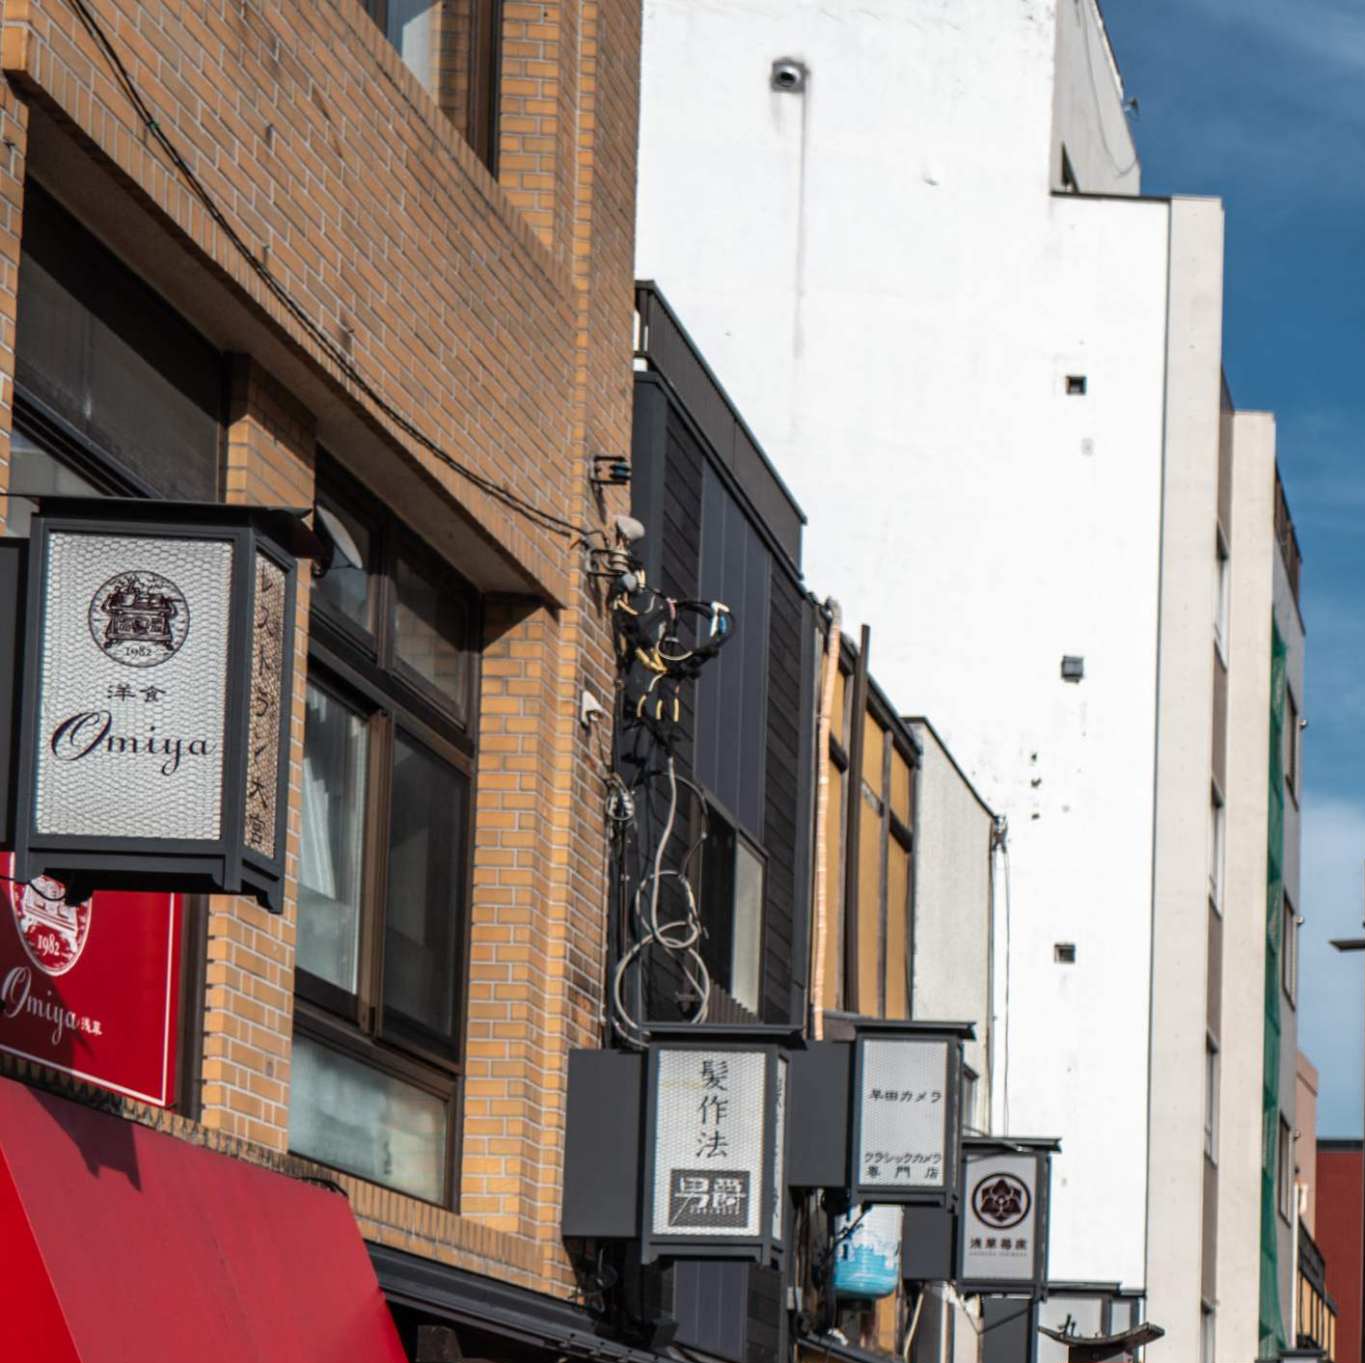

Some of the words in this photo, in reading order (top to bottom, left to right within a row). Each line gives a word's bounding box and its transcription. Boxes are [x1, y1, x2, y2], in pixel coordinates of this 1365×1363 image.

[124, 646, 152, 658] 1982
[106, 684, 167, 703] 洋食
[51, 710, 216, 777] Omiya
[37, 934, 60, 956] 1982
[2, 966, 80, 1045] Omiya
[868, 1087, 942, 1104] 早田カメラ
[696, 1060, 729, 1159] 髪作法
[864, 1151, 942, 1165] クラシックカメラ
